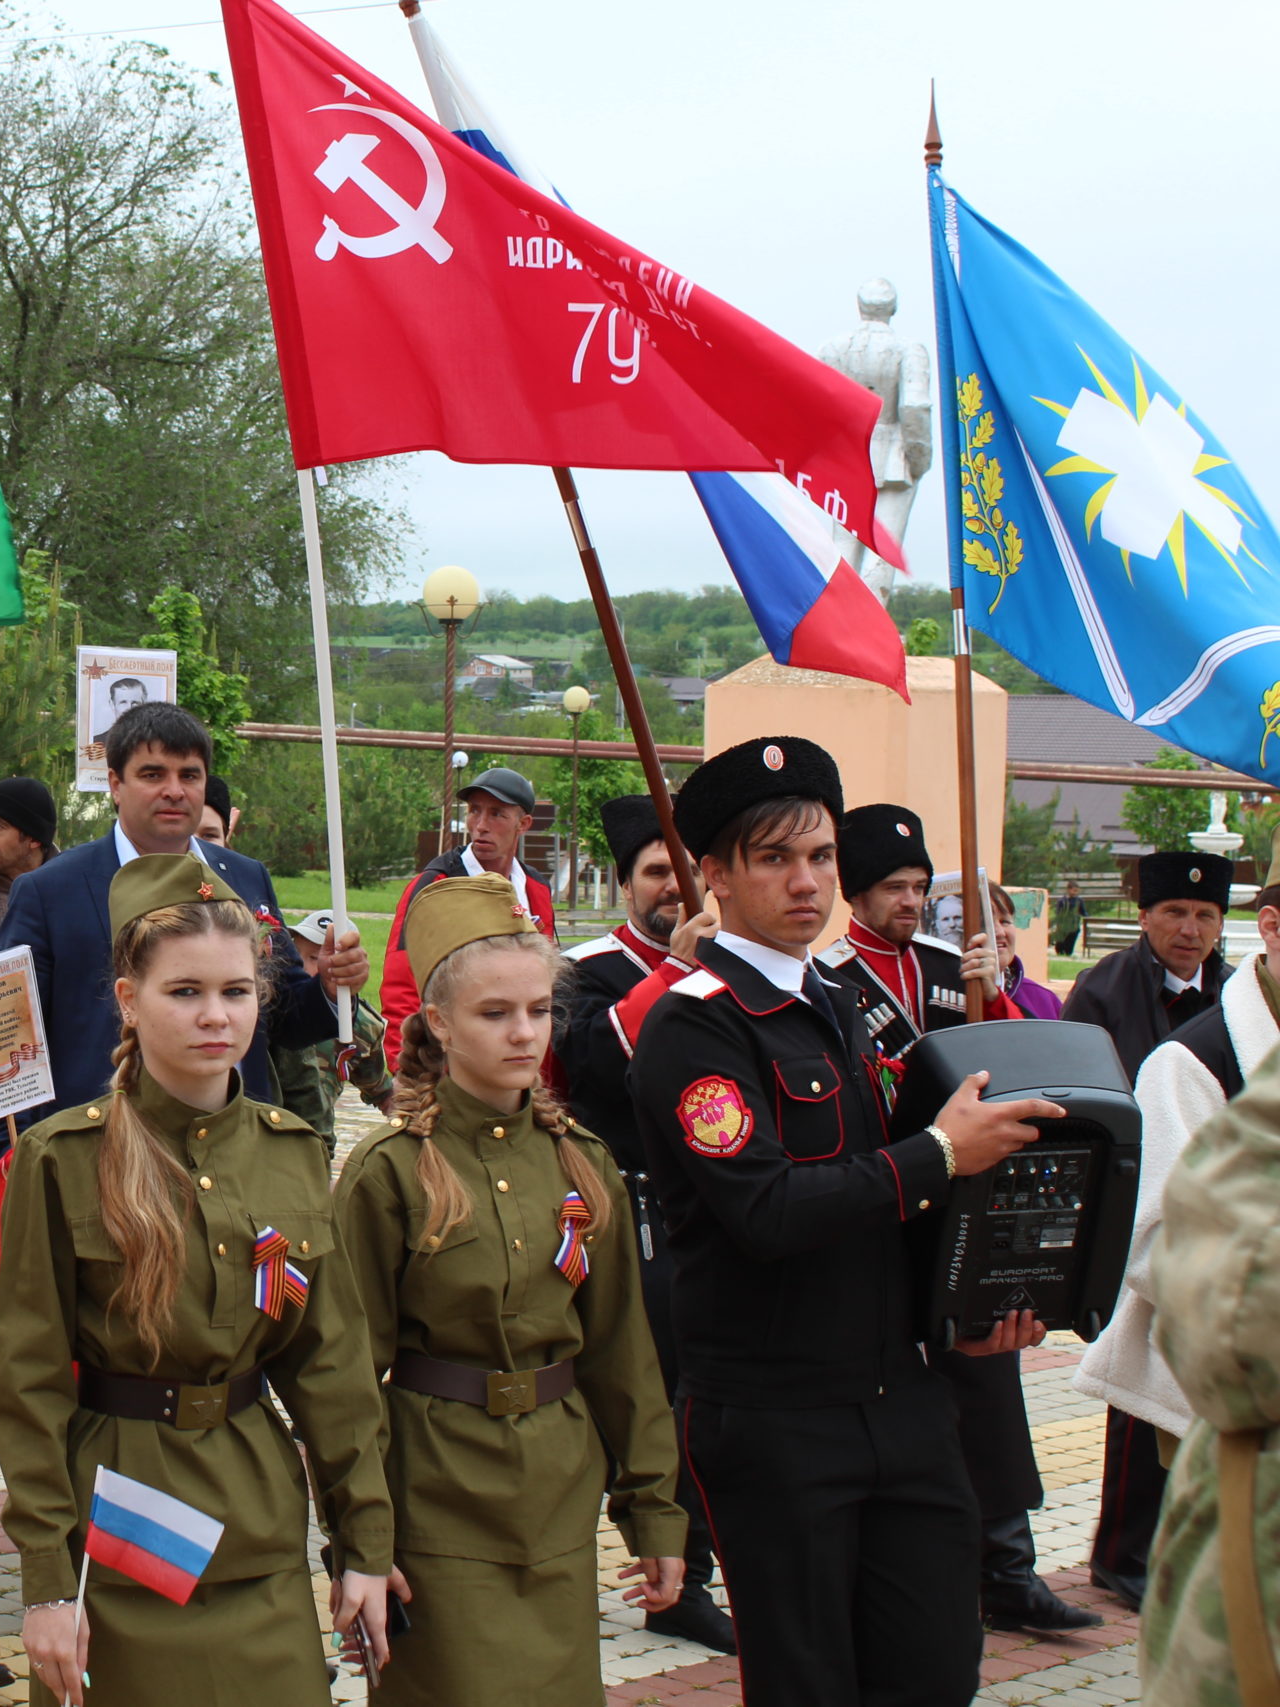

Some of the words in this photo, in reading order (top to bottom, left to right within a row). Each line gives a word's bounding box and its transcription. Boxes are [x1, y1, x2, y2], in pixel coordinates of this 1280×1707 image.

[567, 301, 641, 385] 79
[109, 657, 155, 672] БЕССМЕРТНЫЙ
[156, 661, 175, 673] ПОЛК
[11, 957, 30, 970] ПОЛК
[990, 1267, 1057, 1277] EUROPORT
